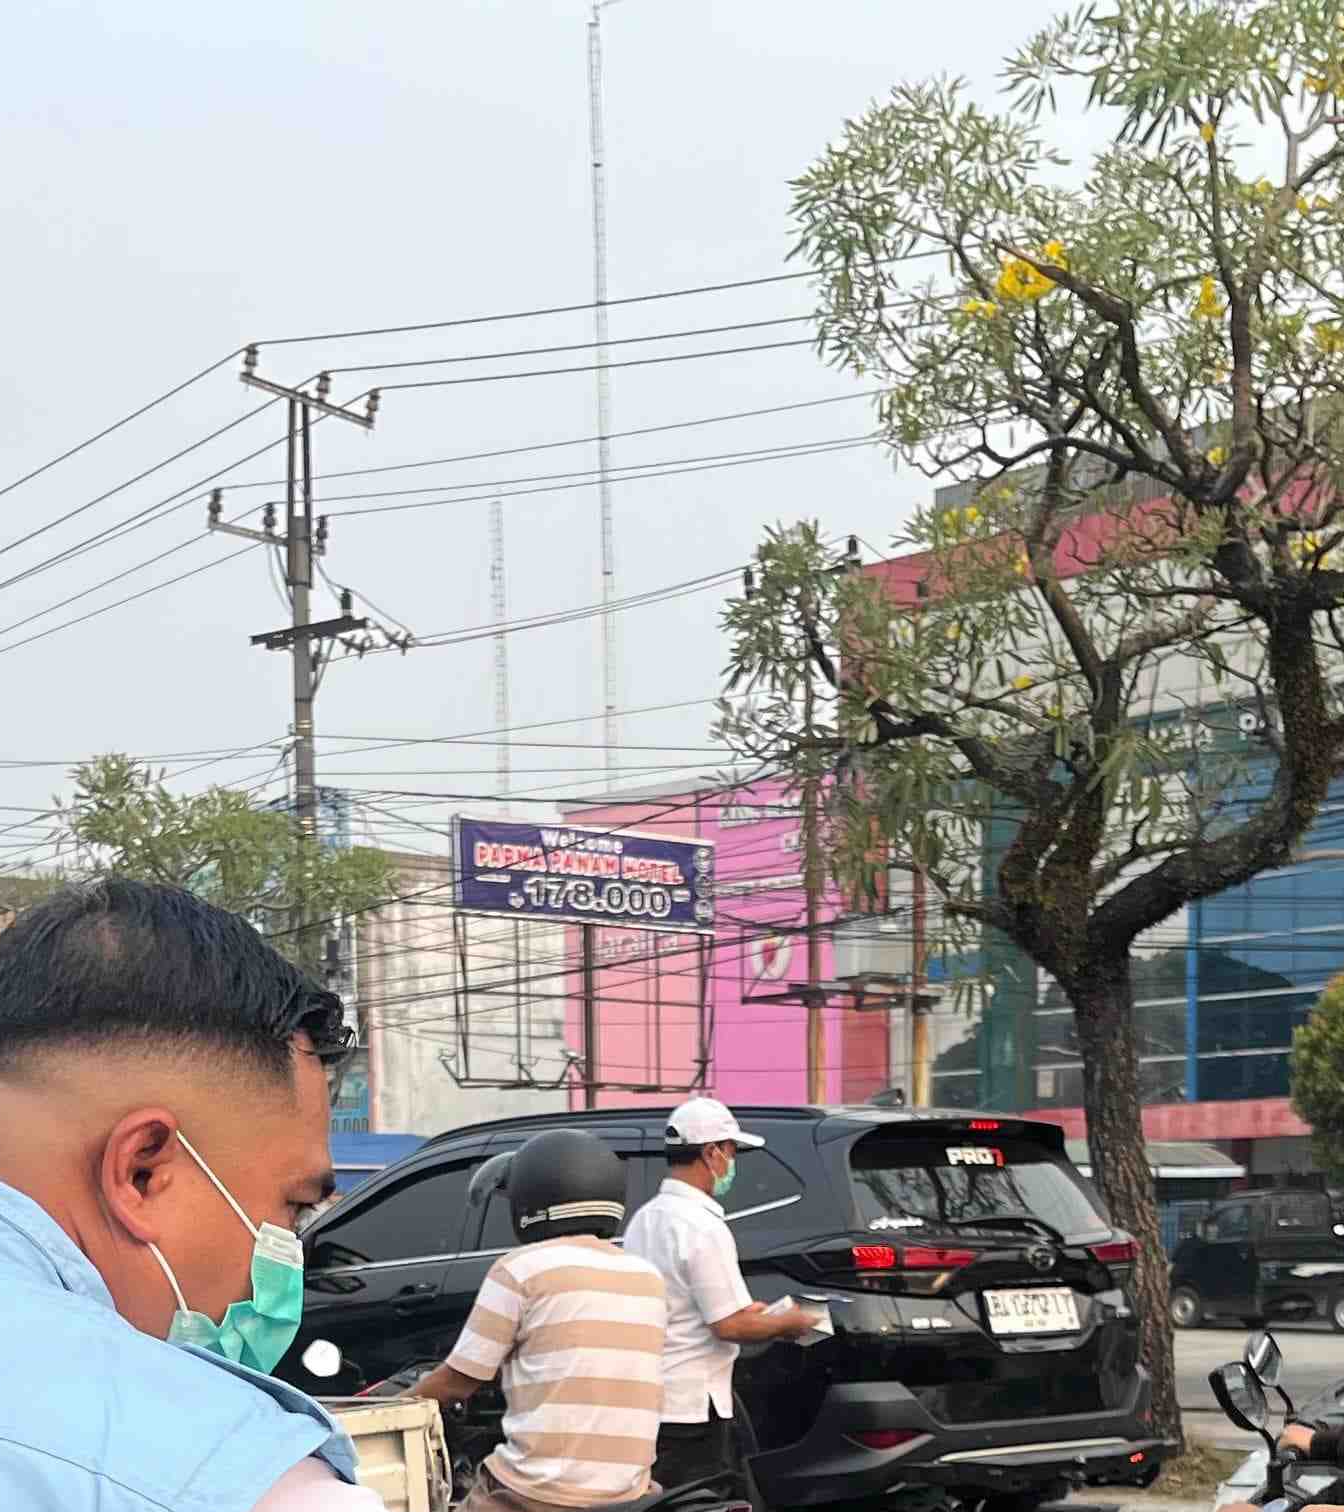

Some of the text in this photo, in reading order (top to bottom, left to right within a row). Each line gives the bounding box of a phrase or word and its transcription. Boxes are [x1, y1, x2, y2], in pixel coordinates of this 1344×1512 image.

[540, 829, 623, 854] Welcome
[548, 848, 620, 879] PANAM
[622, 856, 684, 885] HOTEL
[524, 877, 671, 918] 178.000
